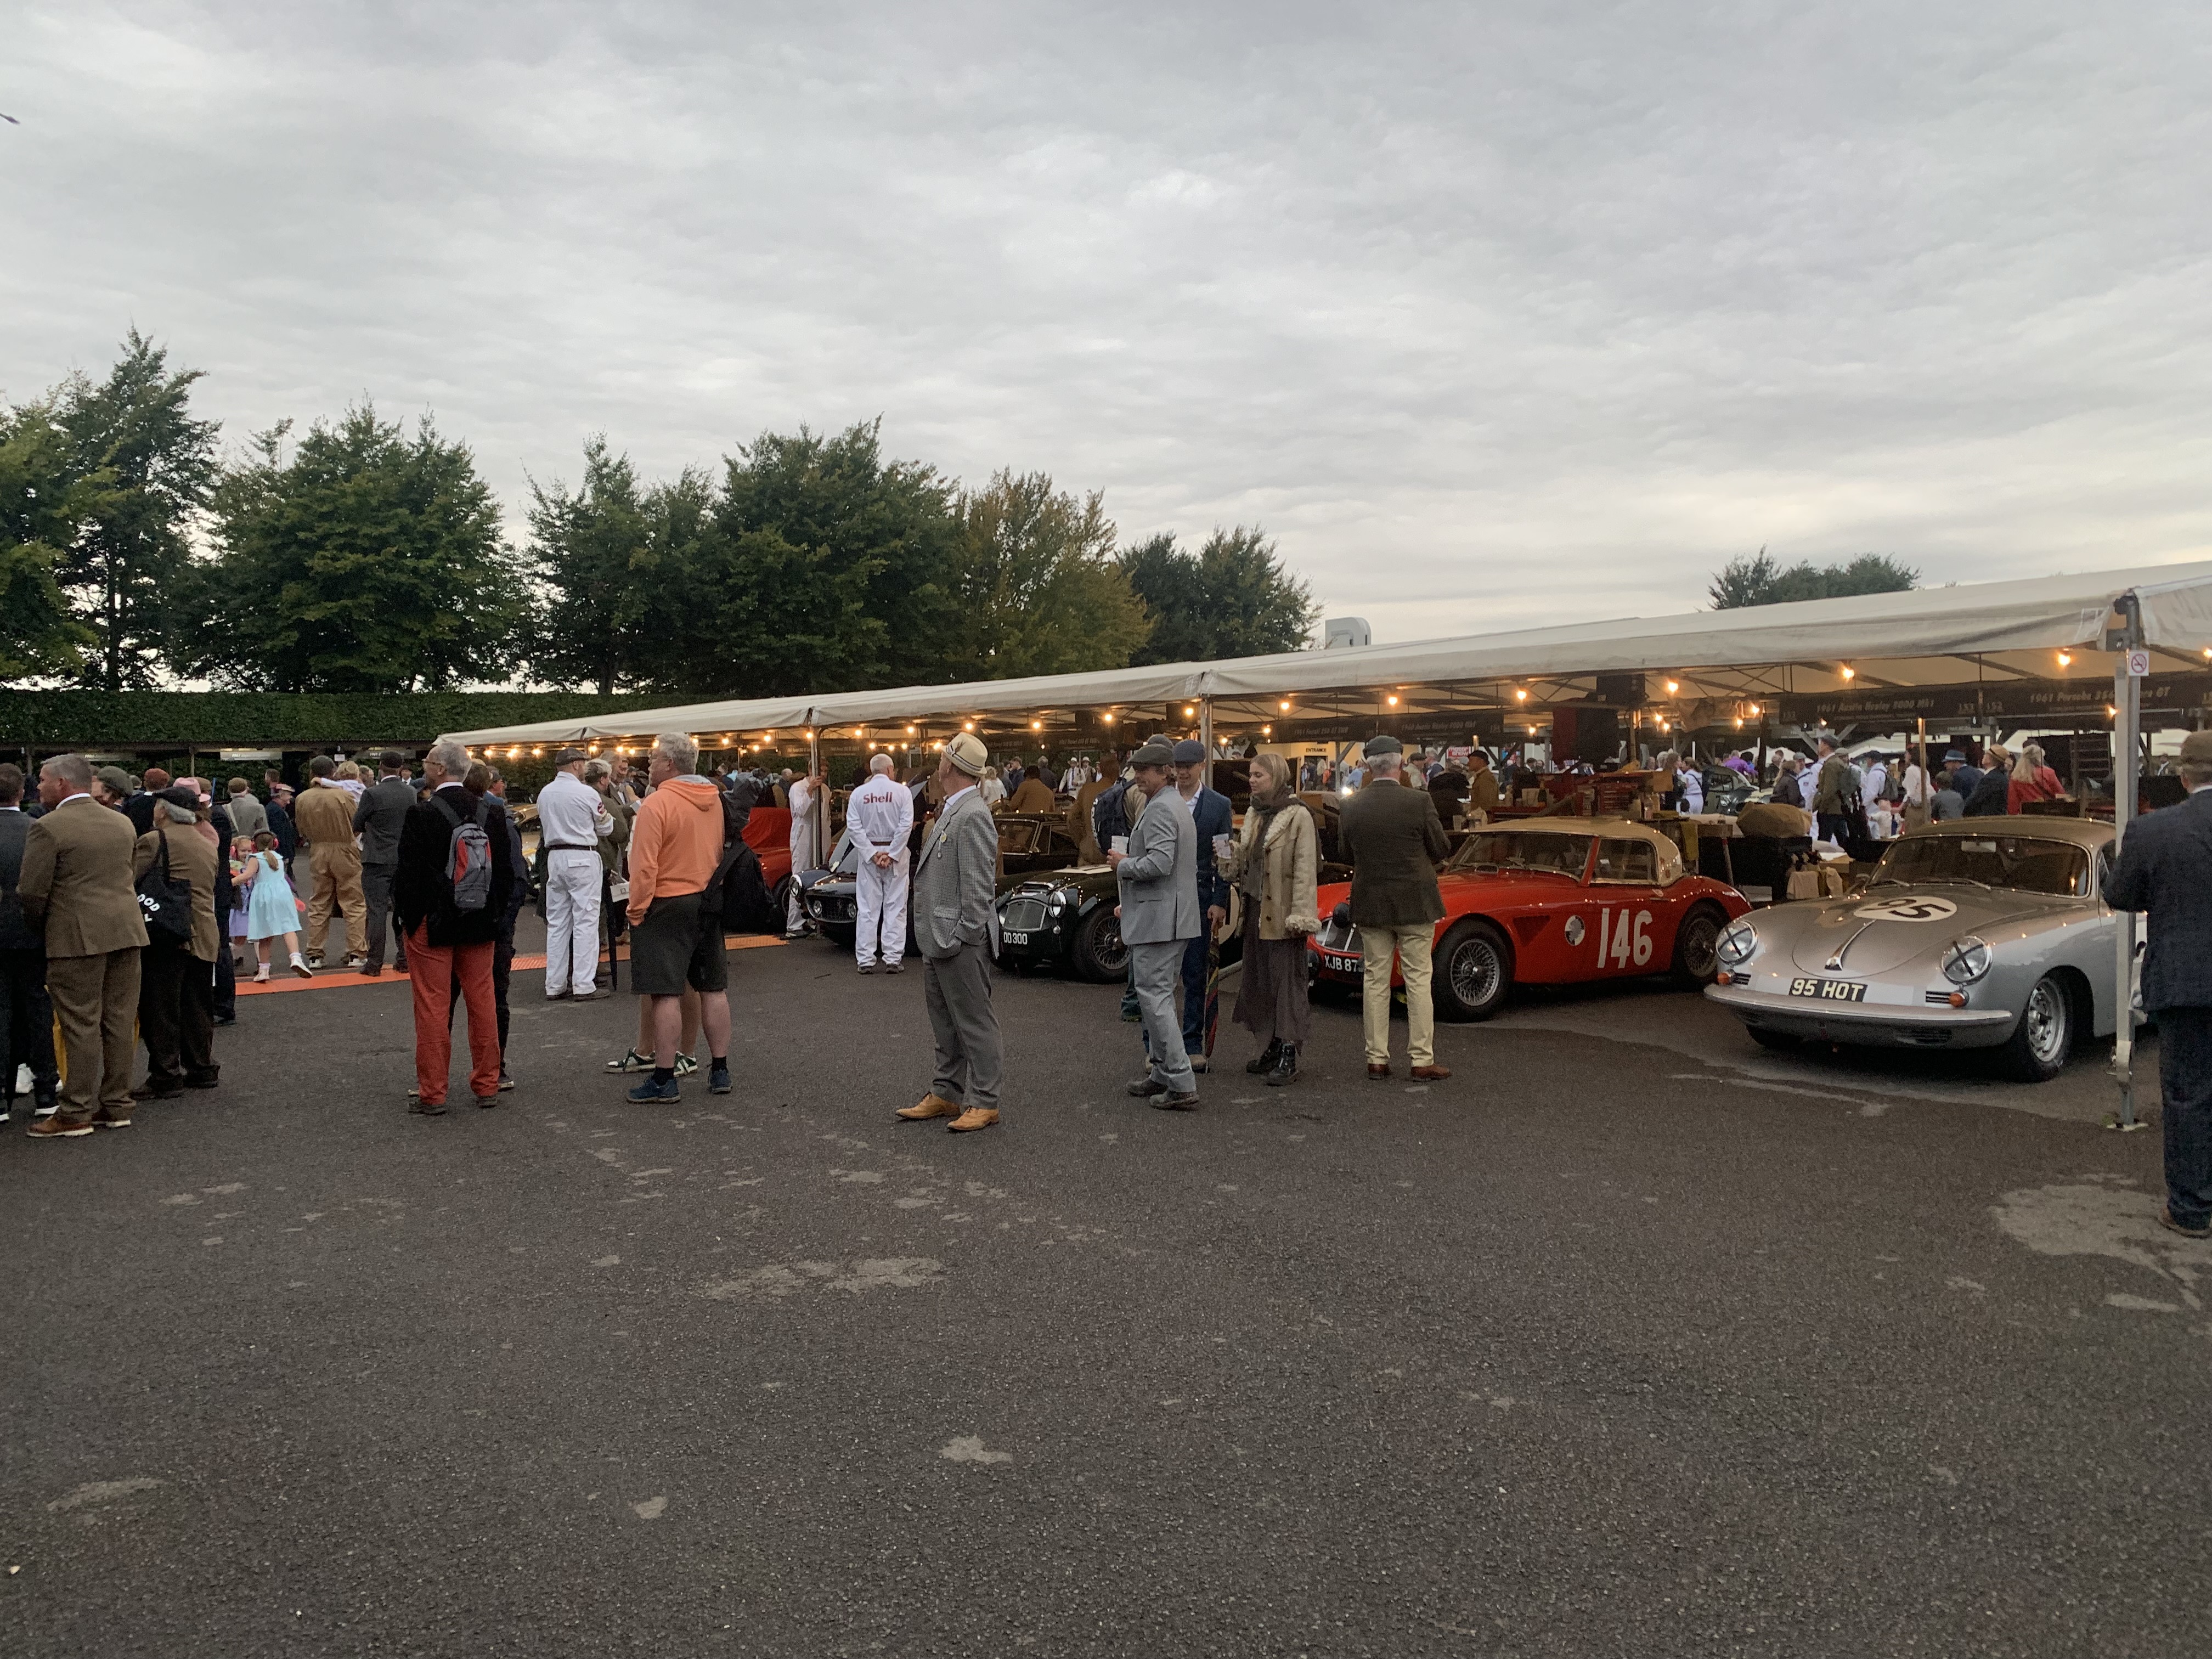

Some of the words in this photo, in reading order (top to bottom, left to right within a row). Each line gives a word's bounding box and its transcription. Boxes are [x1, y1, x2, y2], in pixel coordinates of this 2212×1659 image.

[863, 792, 893, 804] Shell
[1860, 899, 1952, 918] 95
[1597, 907, 1653, 969] 146
[1324, 955, 1342, 970] XJB
[1344, 958, 1364, 972] 87
[1791, 979, 1818, 996] 95
[1821, 981, 1864, 1001] HOT
